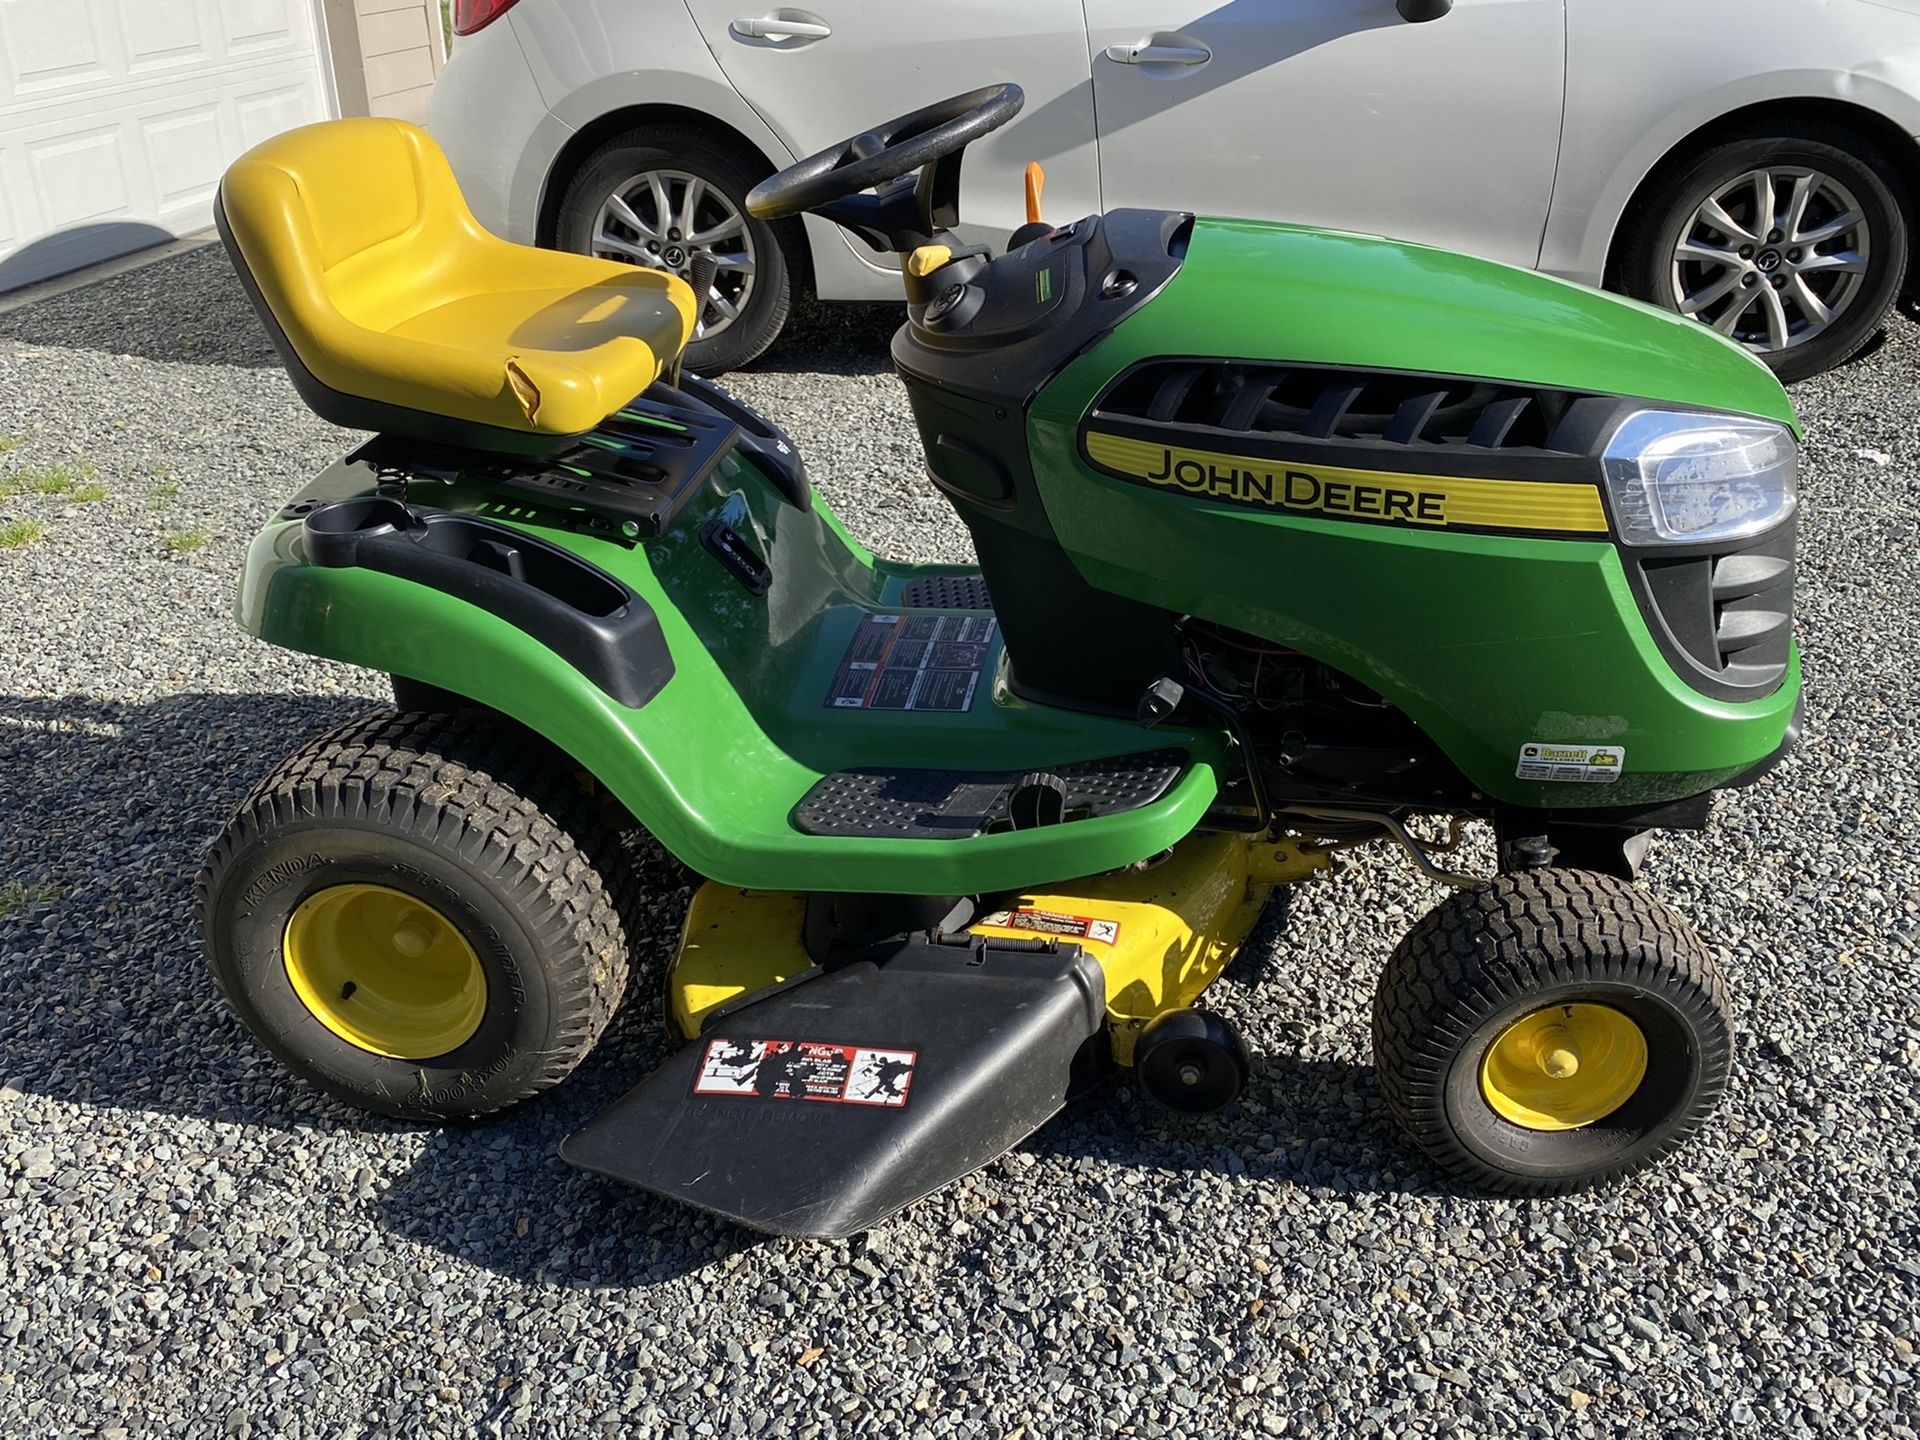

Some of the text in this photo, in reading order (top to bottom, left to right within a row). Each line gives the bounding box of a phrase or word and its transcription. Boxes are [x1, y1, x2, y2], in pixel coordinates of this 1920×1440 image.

[1147, 449, 1447, 522] JOHN DEERE
[1541, 747, 1588, 759] Barnett
[243, 852, 327, 908] KENDA
